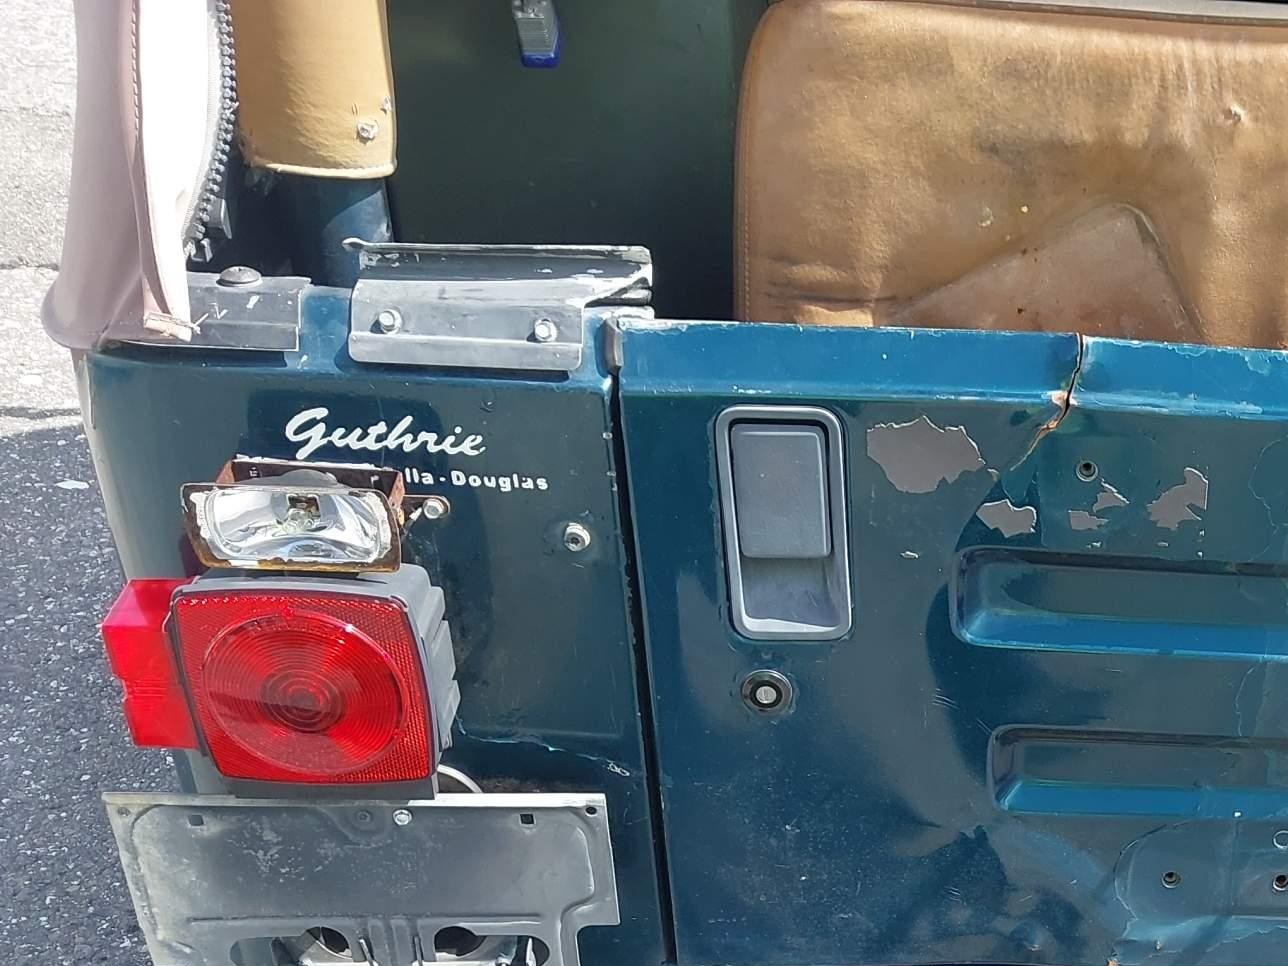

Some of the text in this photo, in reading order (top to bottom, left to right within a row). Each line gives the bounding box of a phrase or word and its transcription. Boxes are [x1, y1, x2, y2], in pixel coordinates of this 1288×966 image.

[285, 407, 486, 460] Guthrie
[404, 467, 434, 485] lla
[450, 470, 549, 493] Douglas
